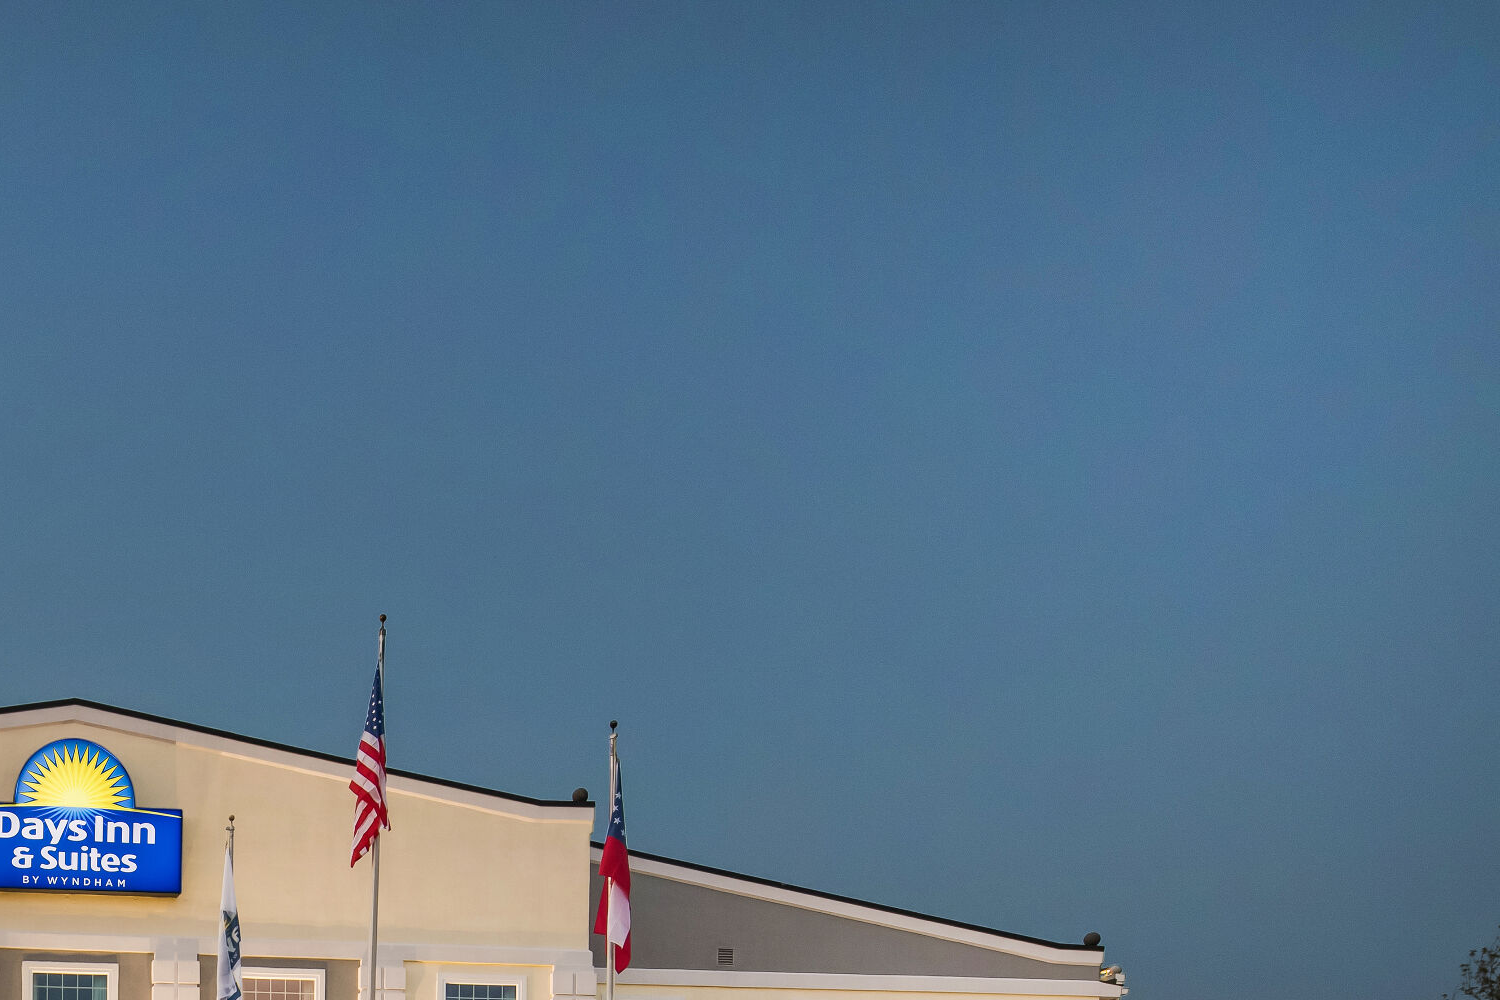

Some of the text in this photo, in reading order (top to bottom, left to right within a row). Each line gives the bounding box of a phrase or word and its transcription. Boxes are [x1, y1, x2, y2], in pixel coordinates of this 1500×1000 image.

[94, 816, 156, 845] Inn
[11, 846, 138, 873] & Suites
[22, 875, 127, 888] BY WYNDHAM
